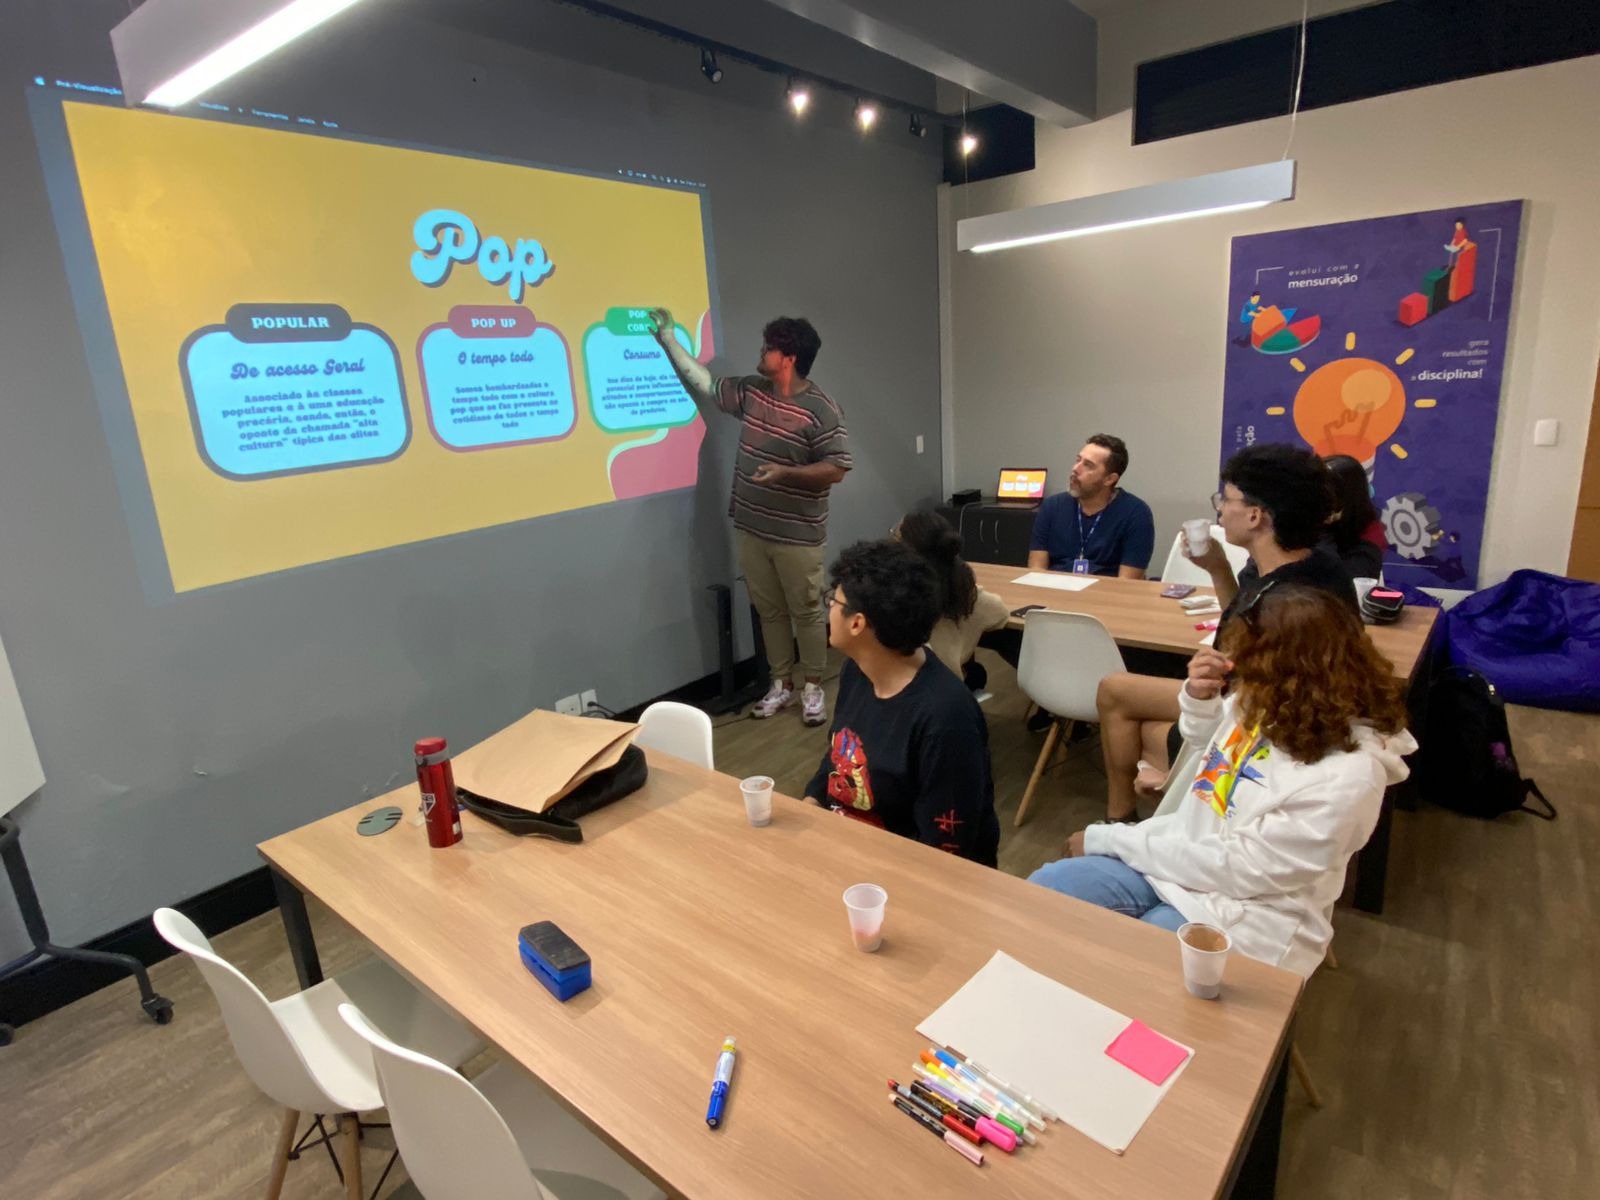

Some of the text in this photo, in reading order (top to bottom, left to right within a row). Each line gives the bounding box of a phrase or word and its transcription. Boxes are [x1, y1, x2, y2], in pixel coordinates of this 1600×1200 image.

[410, 208, 556, 304] Pop
[1288, 274, 1358, 288] mensuração
[628, 310, 647, 318] POP
[251, 317, 330, 329] POPULAR
[471, 318, 516, 328] POP UP
[458, 350, 534, 366] O tempo todo
[624, 348, 660, 360] Consumo
[230, 358, 365, 380] De acesso Geral
[1418, 368, 1484, 382] disciplina!
[244, 392, 302, 402] Associado
[222, 406, 282, 418] populares
[336, 396, 384, 407] educação
[302, 422, 350, 432] chamada
[350, 430, 378, 438] elites
